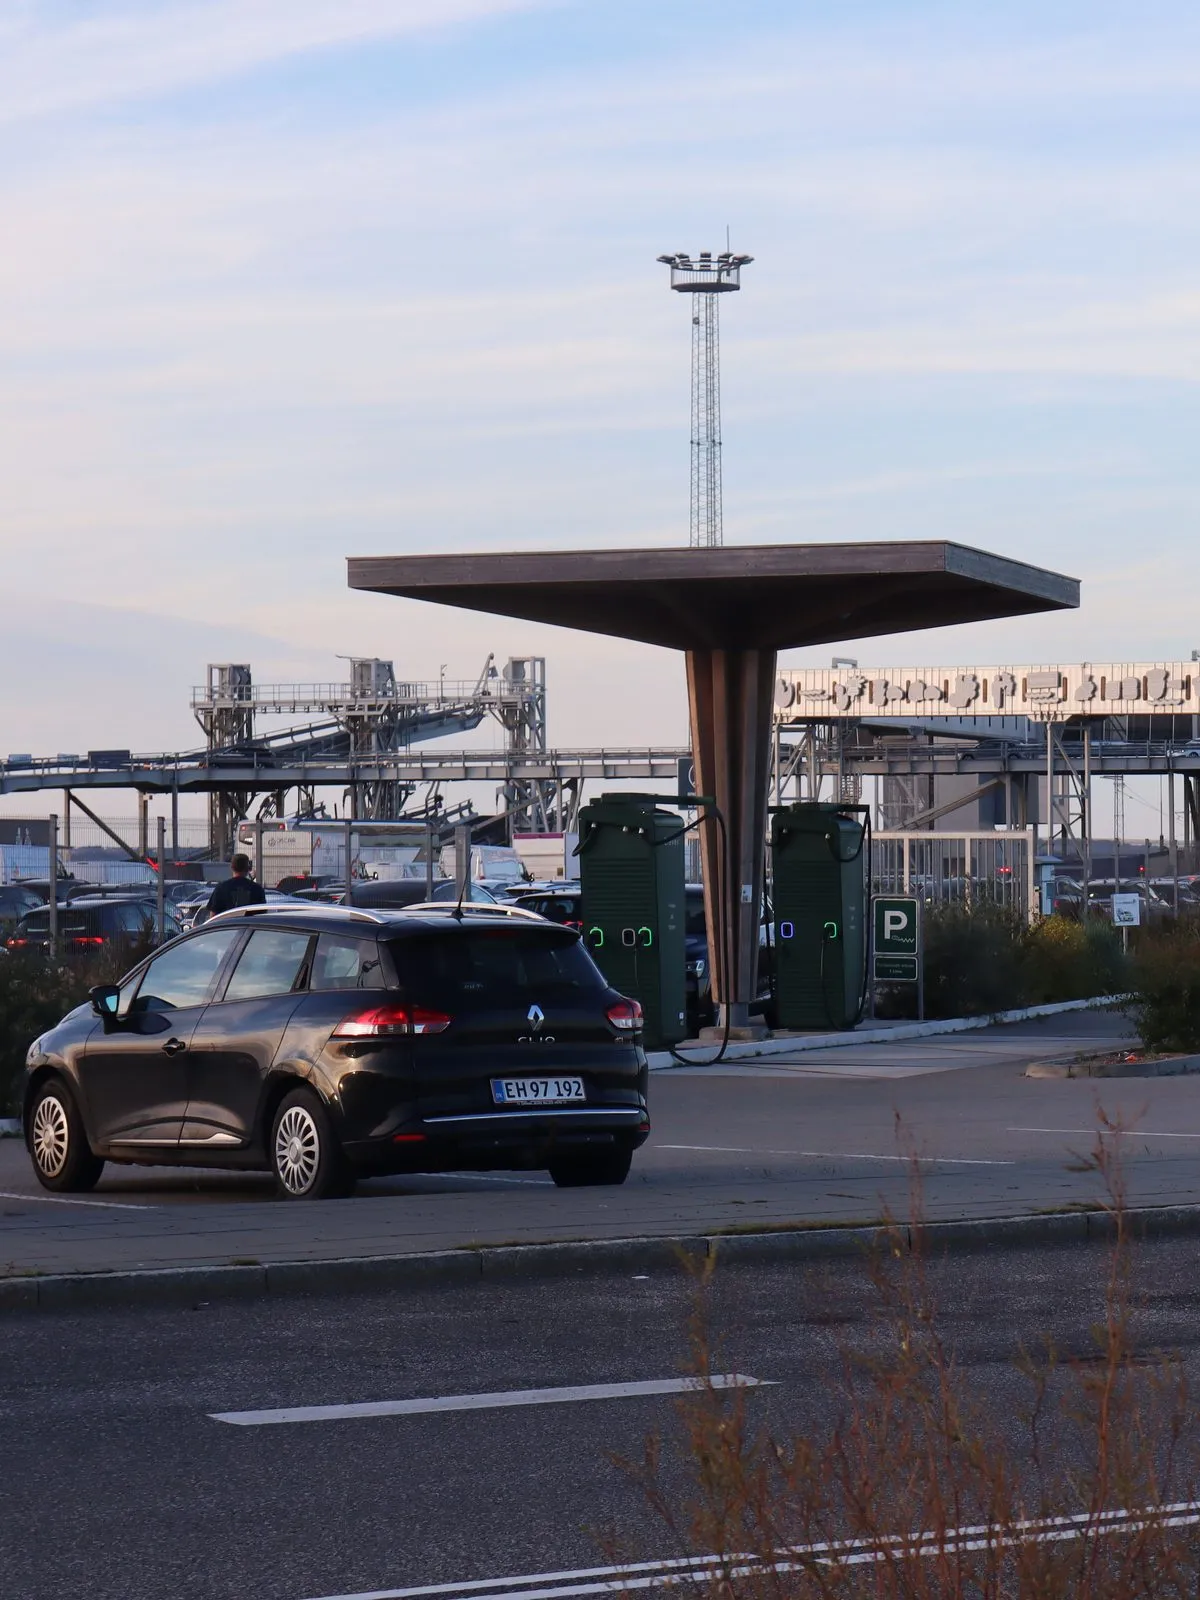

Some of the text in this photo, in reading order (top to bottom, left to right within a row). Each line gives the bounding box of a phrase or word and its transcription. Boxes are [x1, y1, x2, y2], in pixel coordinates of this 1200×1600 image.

[884, 910, 908, 940] P
[504, 1080, 583, 1099] EH 97 192
